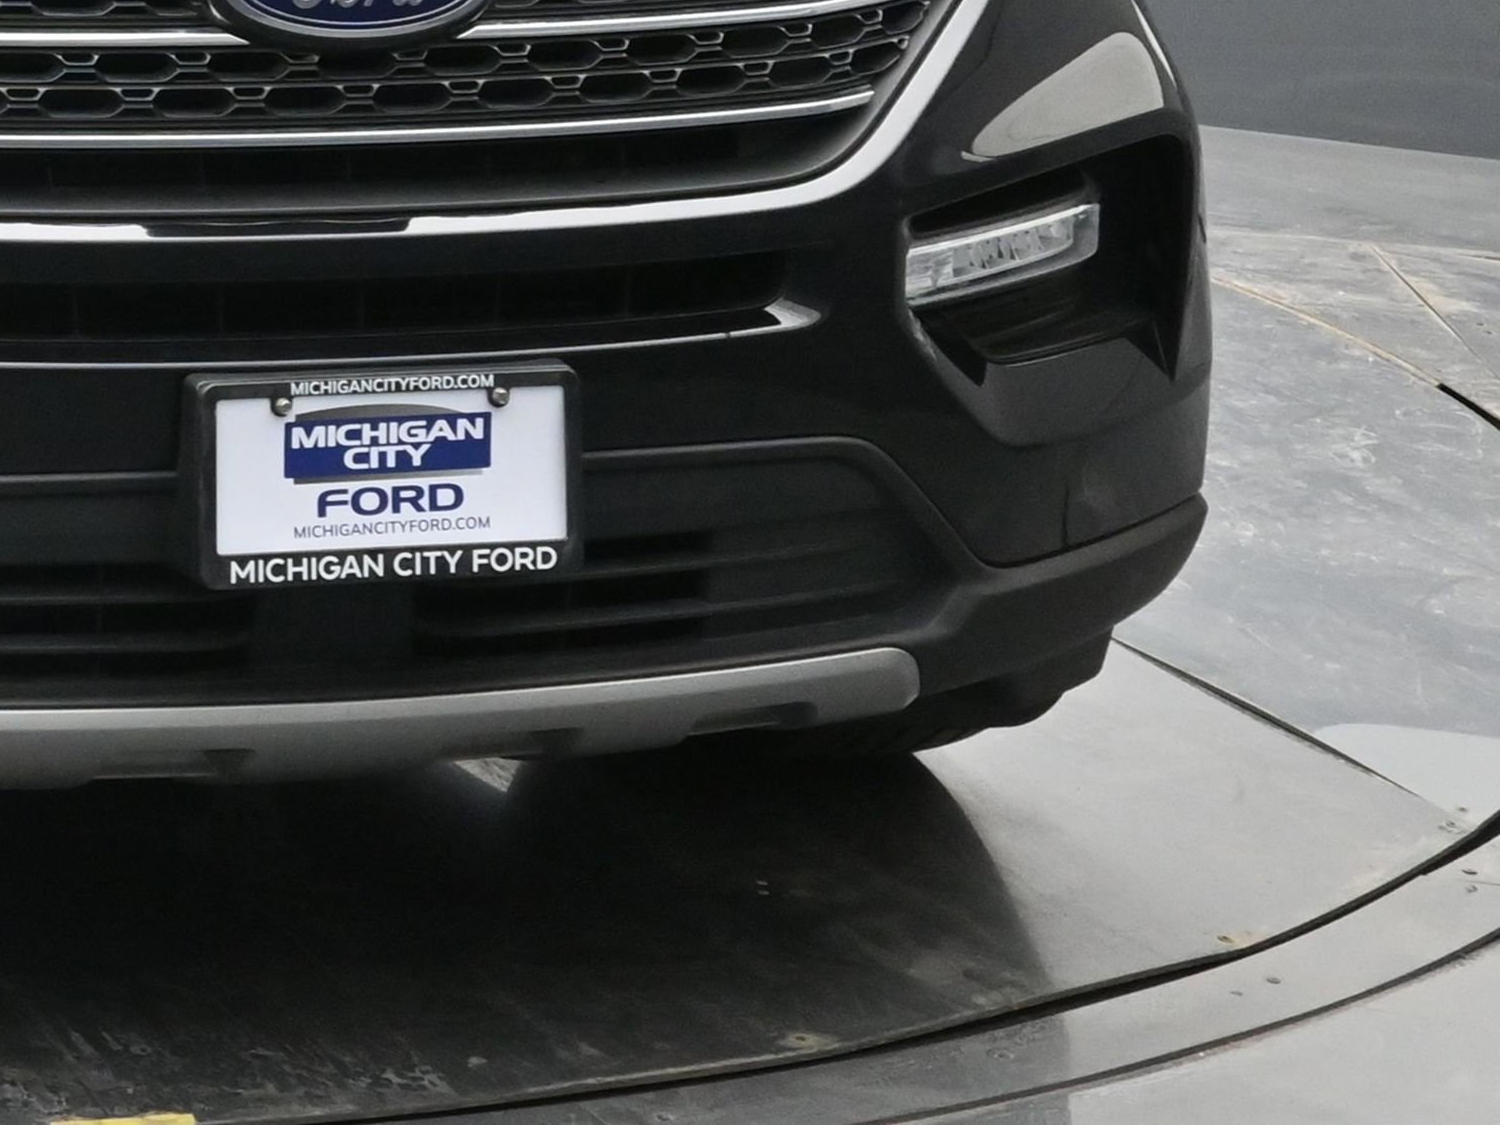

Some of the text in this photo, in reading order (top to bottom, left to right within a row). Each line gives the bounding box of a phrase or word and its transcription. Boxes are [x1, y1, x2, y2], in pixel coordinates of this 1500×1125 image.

[290, 374, 494, 396] MICHIGANCITYFORD.COM
[290, 417, 484, 449] MICHIGAN
[342, 443, 432, 470] CITY
[316, 483, 465, 518] FORD
[293, 516, 491, 538] MICHIGANCITYFORD.COM
[229, 546, 558, 584] MICHIGAN CITY FORD
